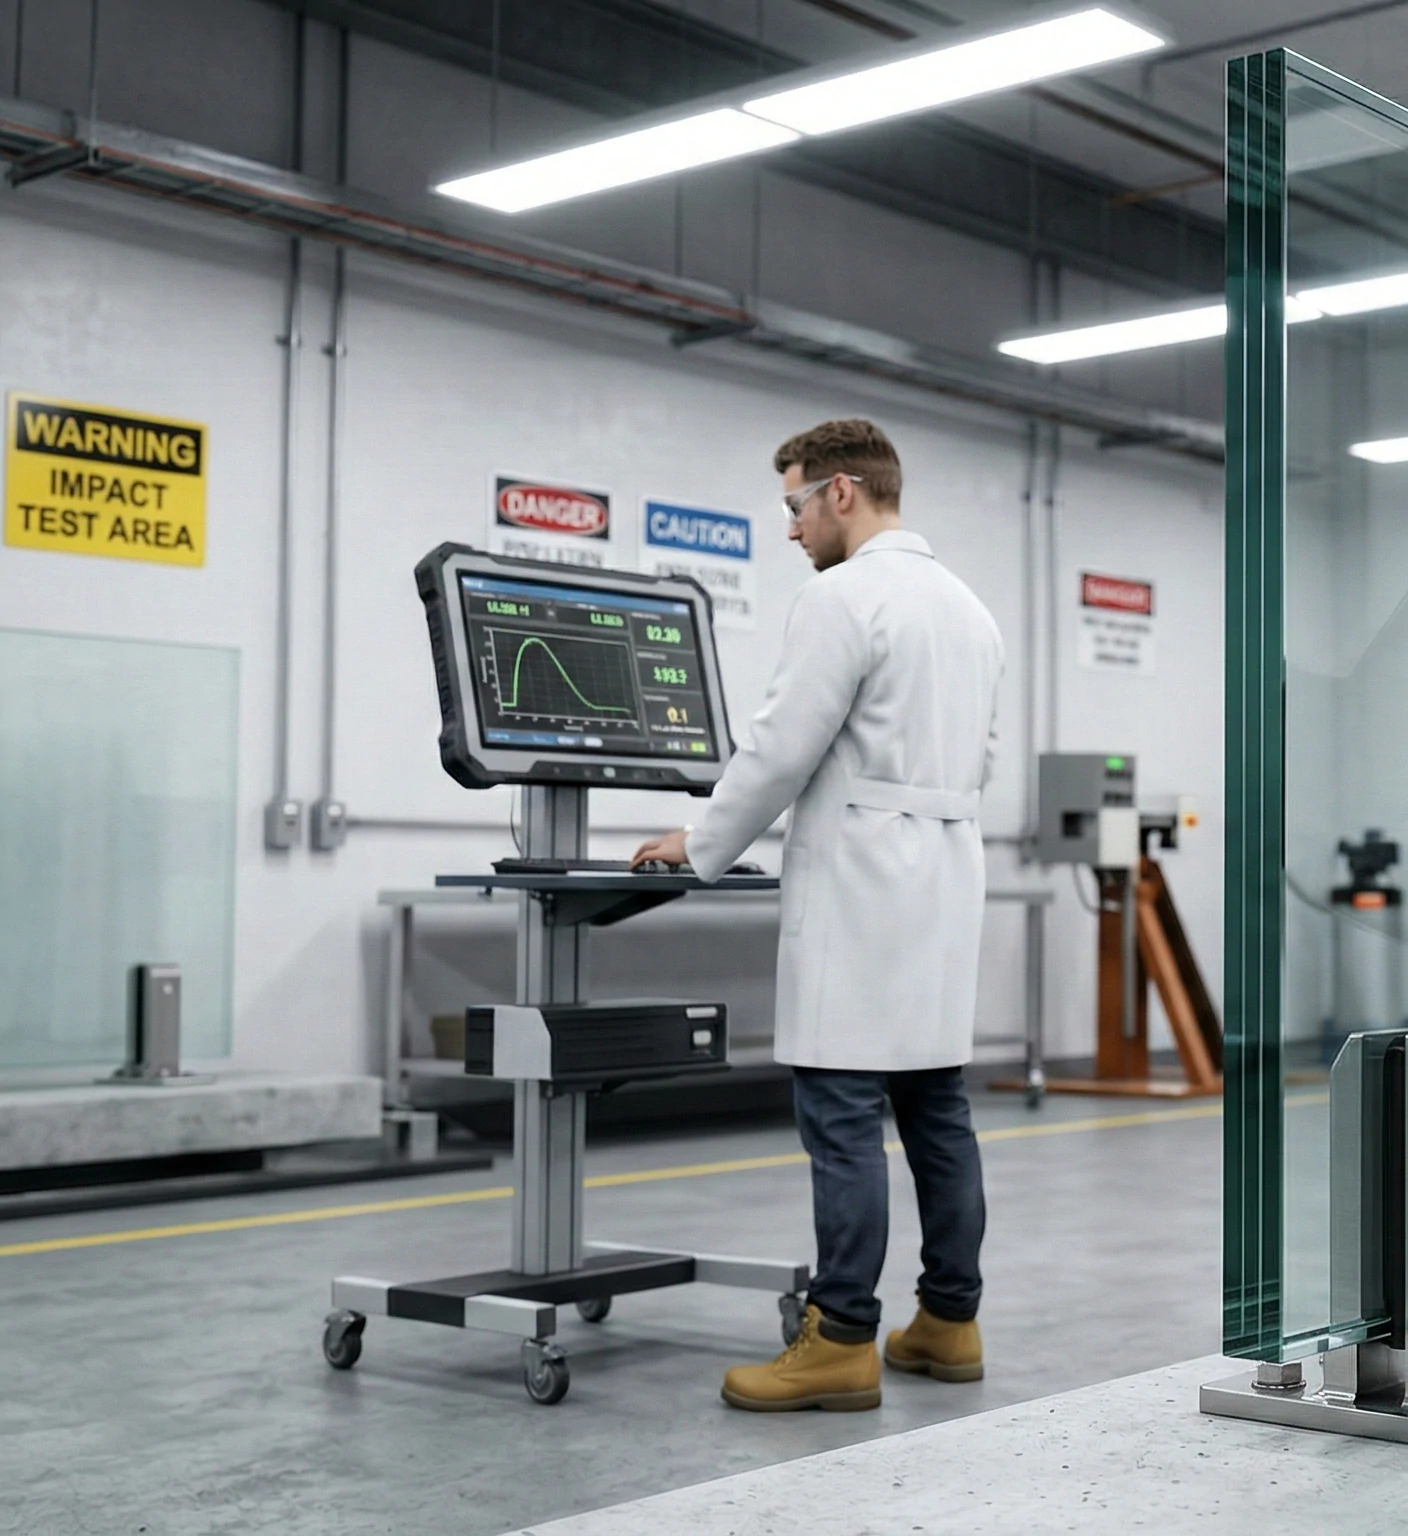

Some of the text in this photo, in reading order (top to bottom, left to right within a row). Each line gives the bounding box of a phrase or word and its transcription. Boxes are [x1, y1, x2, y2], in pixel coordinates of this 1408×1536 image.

[24, 410, 196, 468] WARNING
[50, 468, 168, 510] IMPACT
[506, 490, 601, 528] DANGER
[18, 503, 195, 551] TEST AREA
[650, 511, 747, 550] CAUTION
